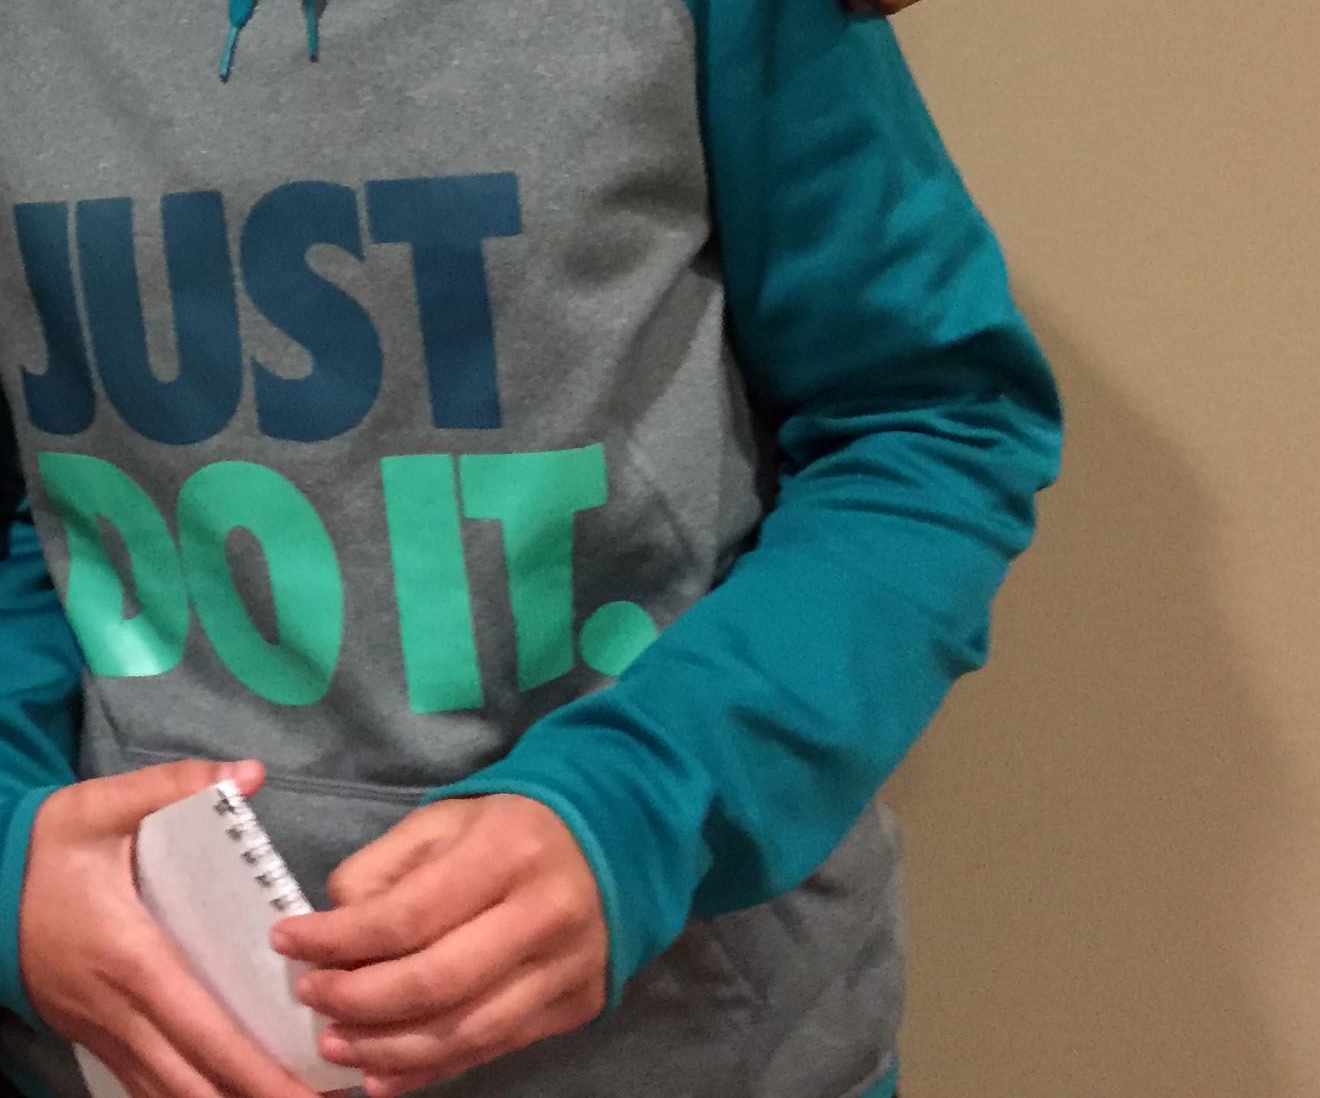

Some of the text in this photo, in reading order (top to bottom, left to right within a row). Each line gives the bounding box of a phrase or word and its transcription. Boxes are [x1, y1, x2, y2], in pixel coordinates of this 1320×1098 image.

[13, 171, 523, 446] JUST
[38, 443, 659, 714] DO IT.
